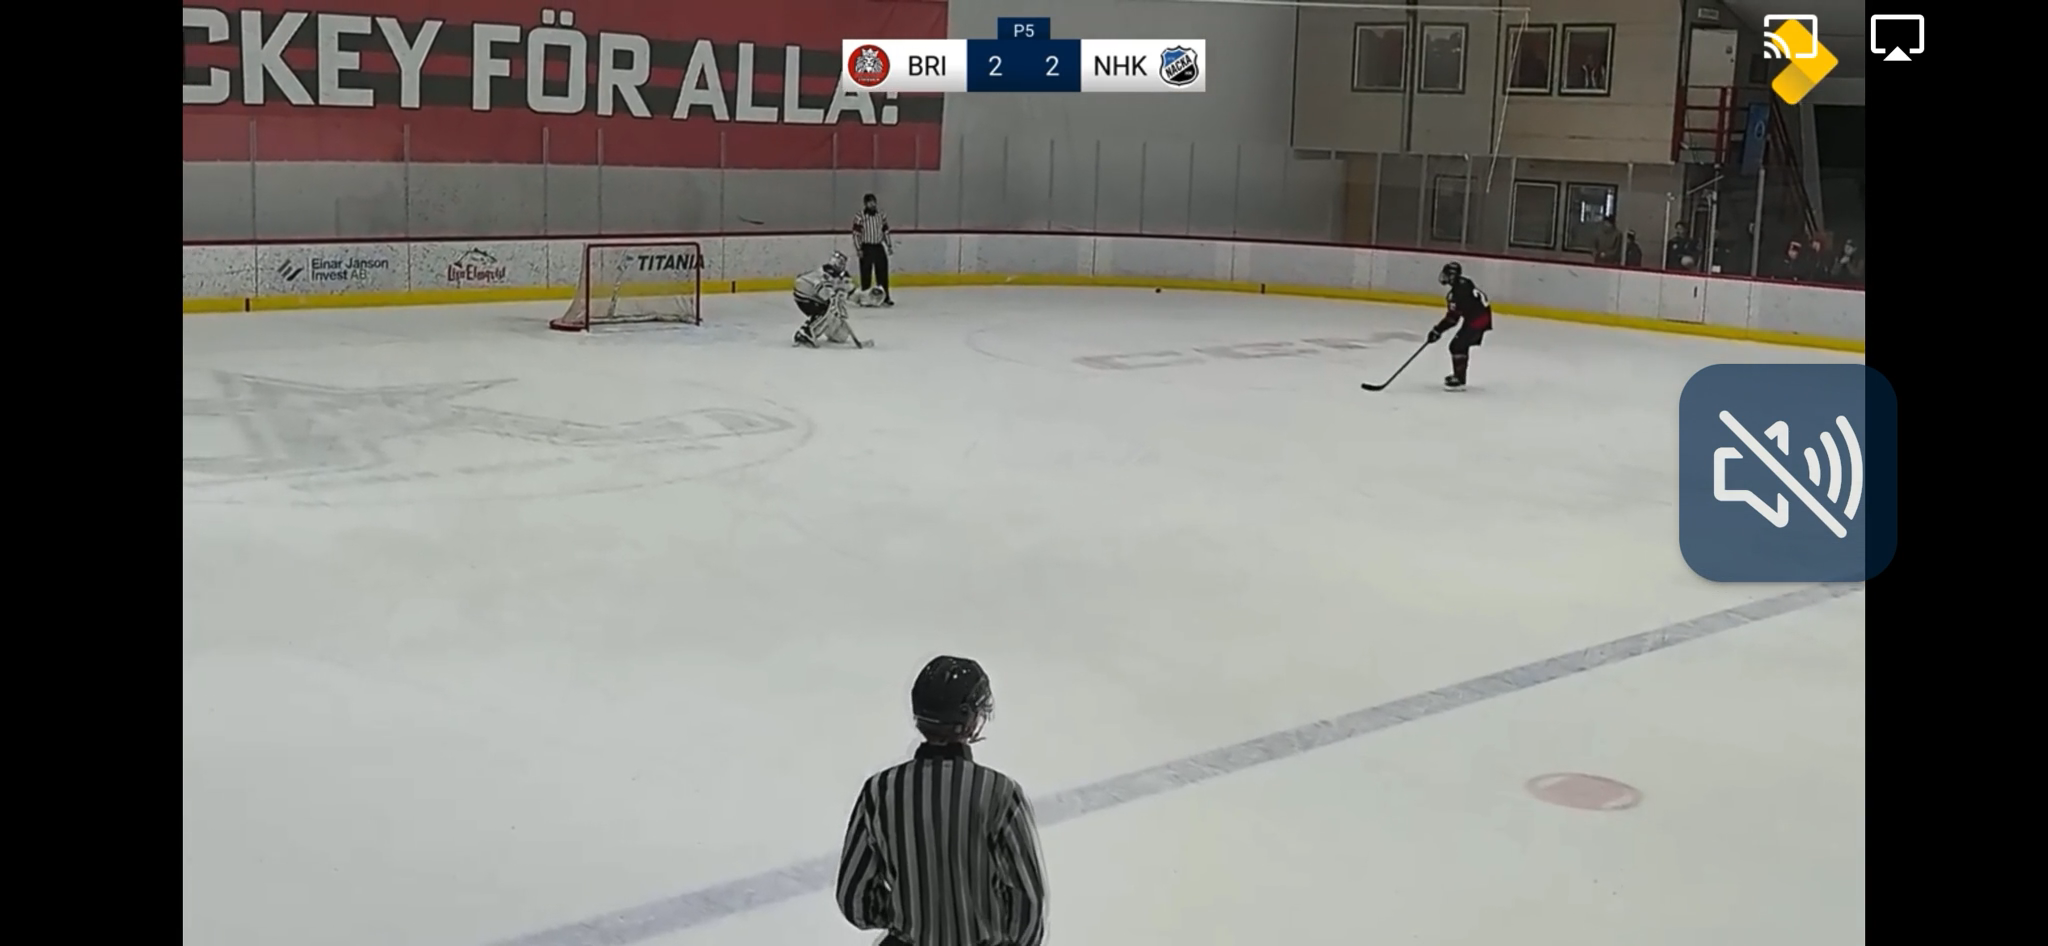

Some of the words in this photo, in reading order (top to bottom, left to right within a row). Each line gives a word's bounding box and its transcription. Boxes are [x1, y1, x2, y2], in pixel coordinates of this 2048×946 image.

[472, 9, 652, 118] FÖR
[311, 258, 341, 270] Einar
[345, 257, 389, 269] Janson
[637, 253, 705, 271] TITANIA
[311, 270, 347, 281] Invest
[350, 269, 367, 279] AB
